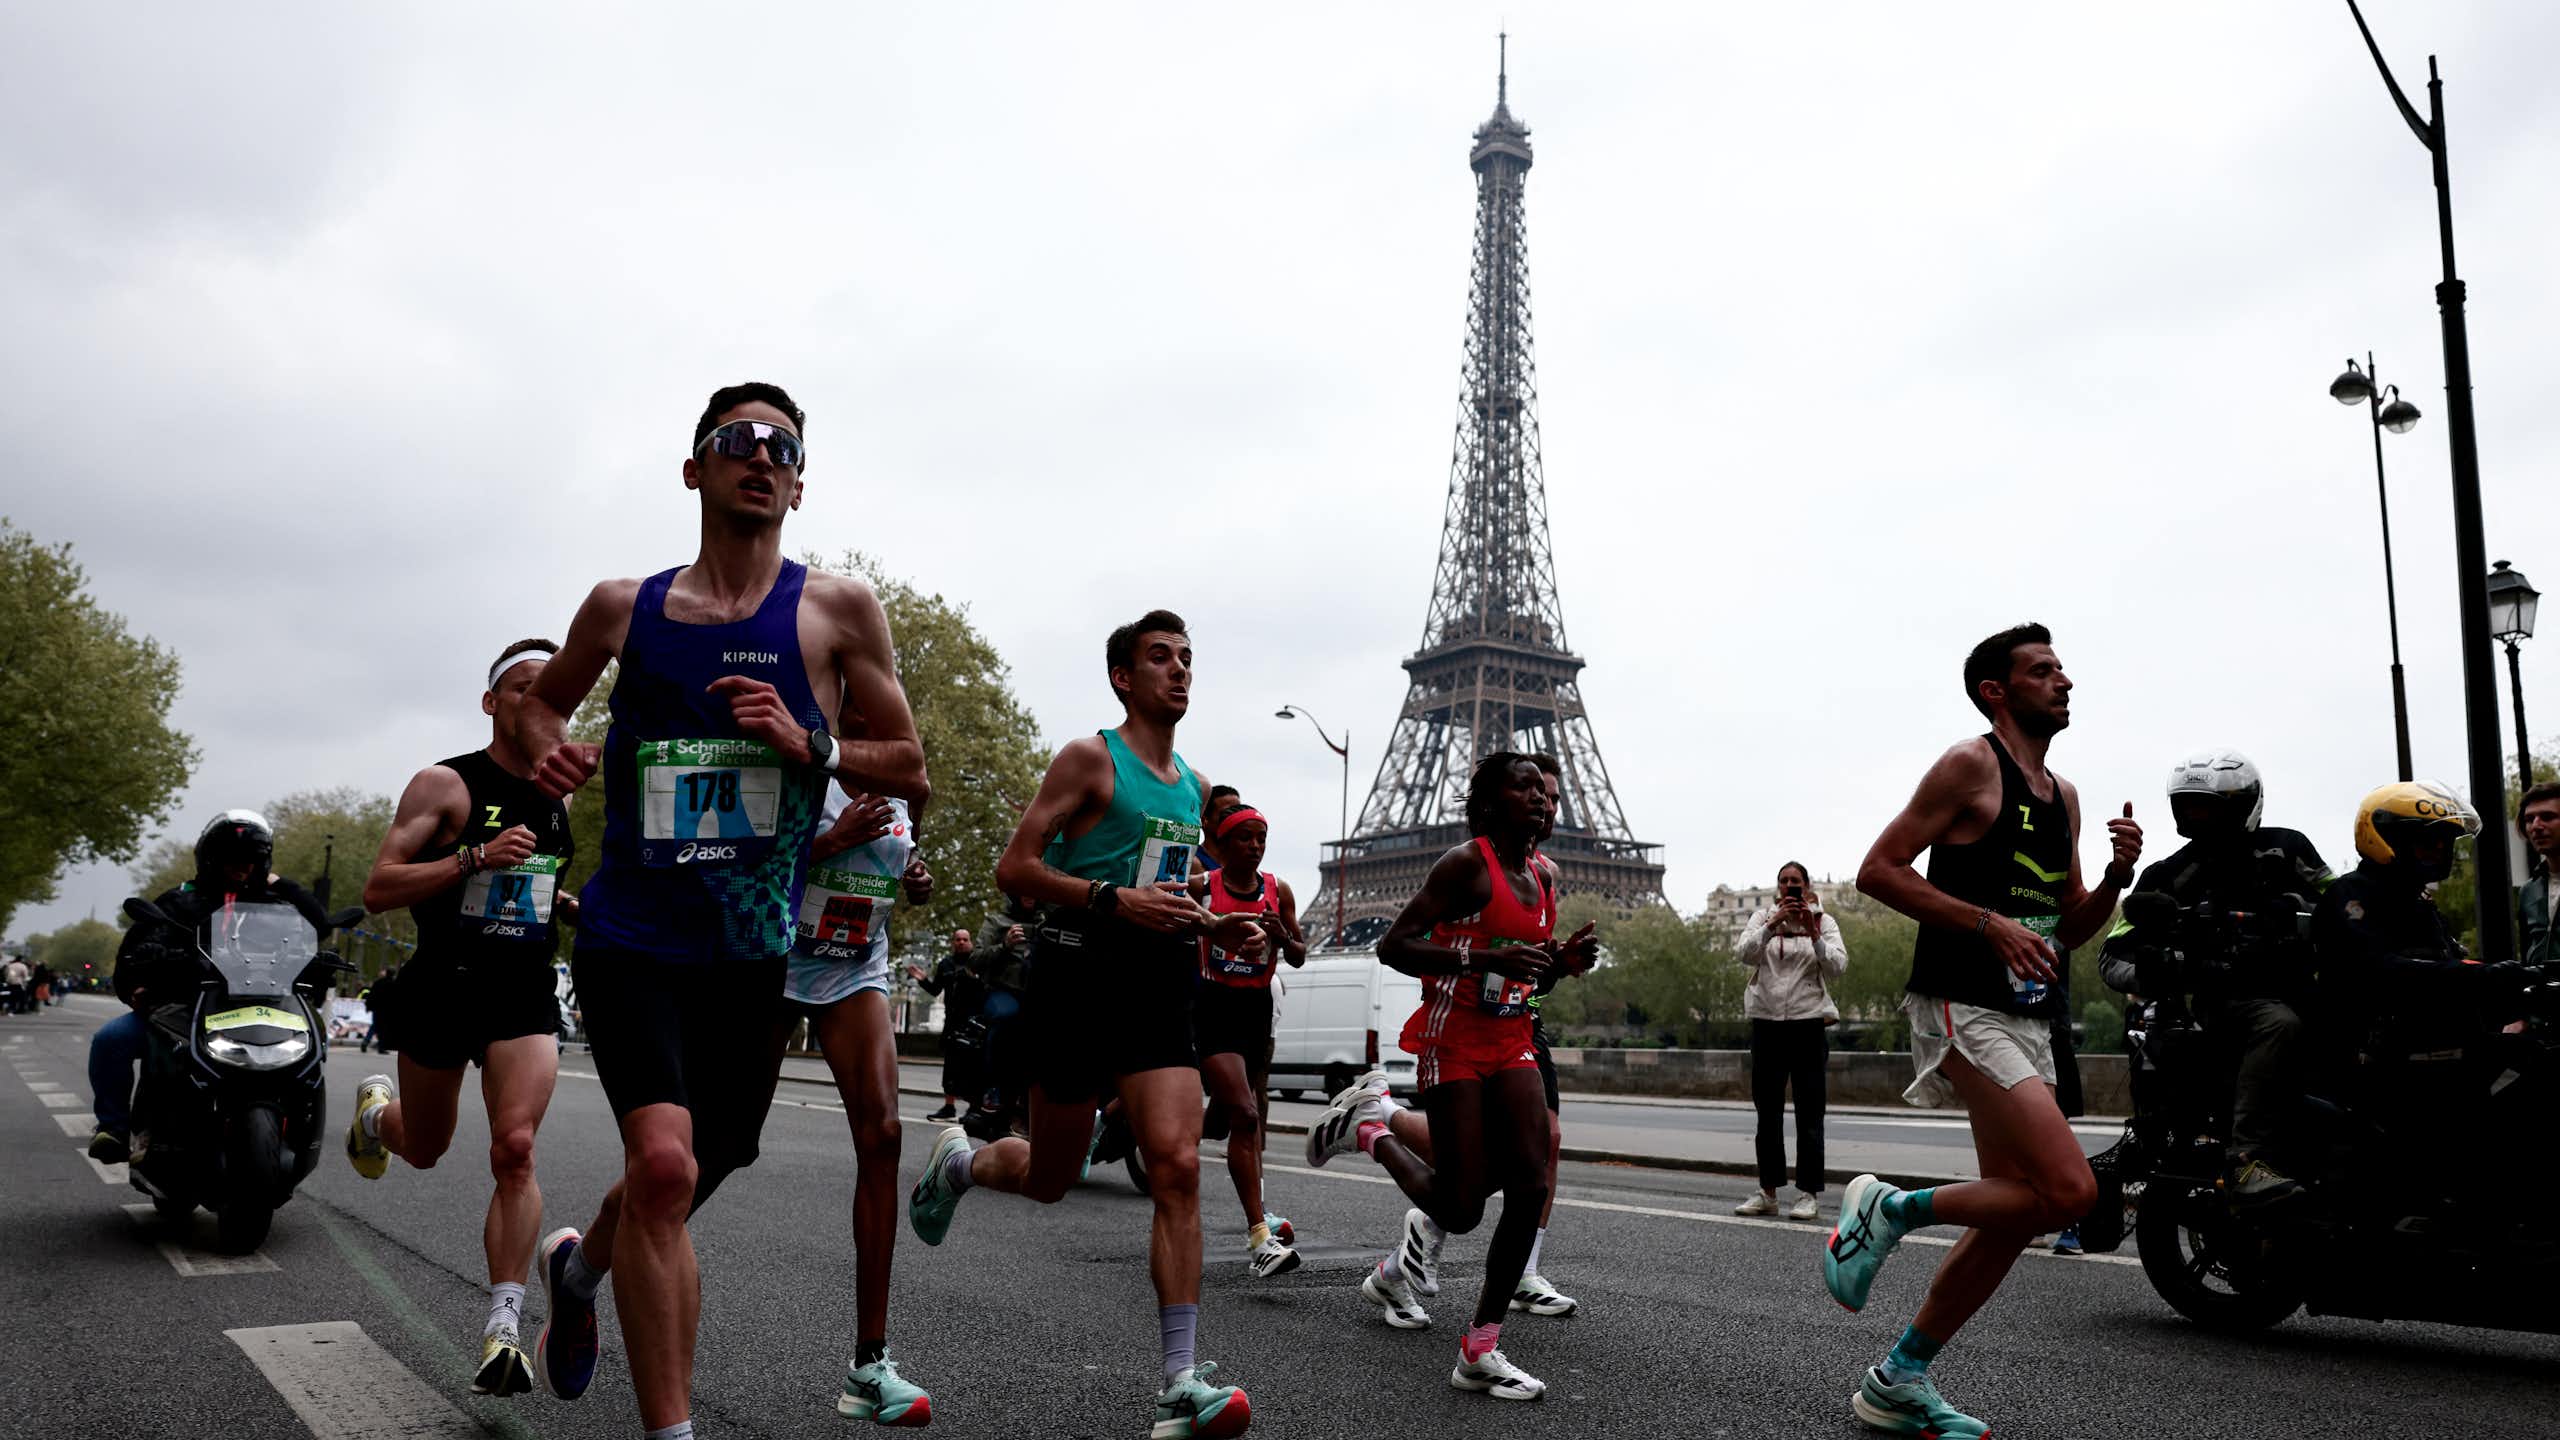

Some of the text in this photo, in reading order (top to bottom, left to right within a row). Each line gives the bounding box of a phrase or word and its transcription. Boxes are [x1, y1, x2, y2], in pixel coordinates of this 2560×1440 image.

[722, 651, 779, 664] KIPRUN
[676, 739, 766, 755] Schneider
[683, 772, 737, 813] 178
[484, 805, 502, 828] Z
[2018, 805, 2034, 831] Z
[696, 846, 738, 860] asics
[1165, 846, 1188, 876] 182
[834, 871, 889, 889] Schneider
[857, 886, 887, 896] Electric
[497, 925, 526, 937] asics
[797, 920, 815, 937] 206
[828, 946, 858, 958] asics
[255, 1007, 272, 1017] 34
